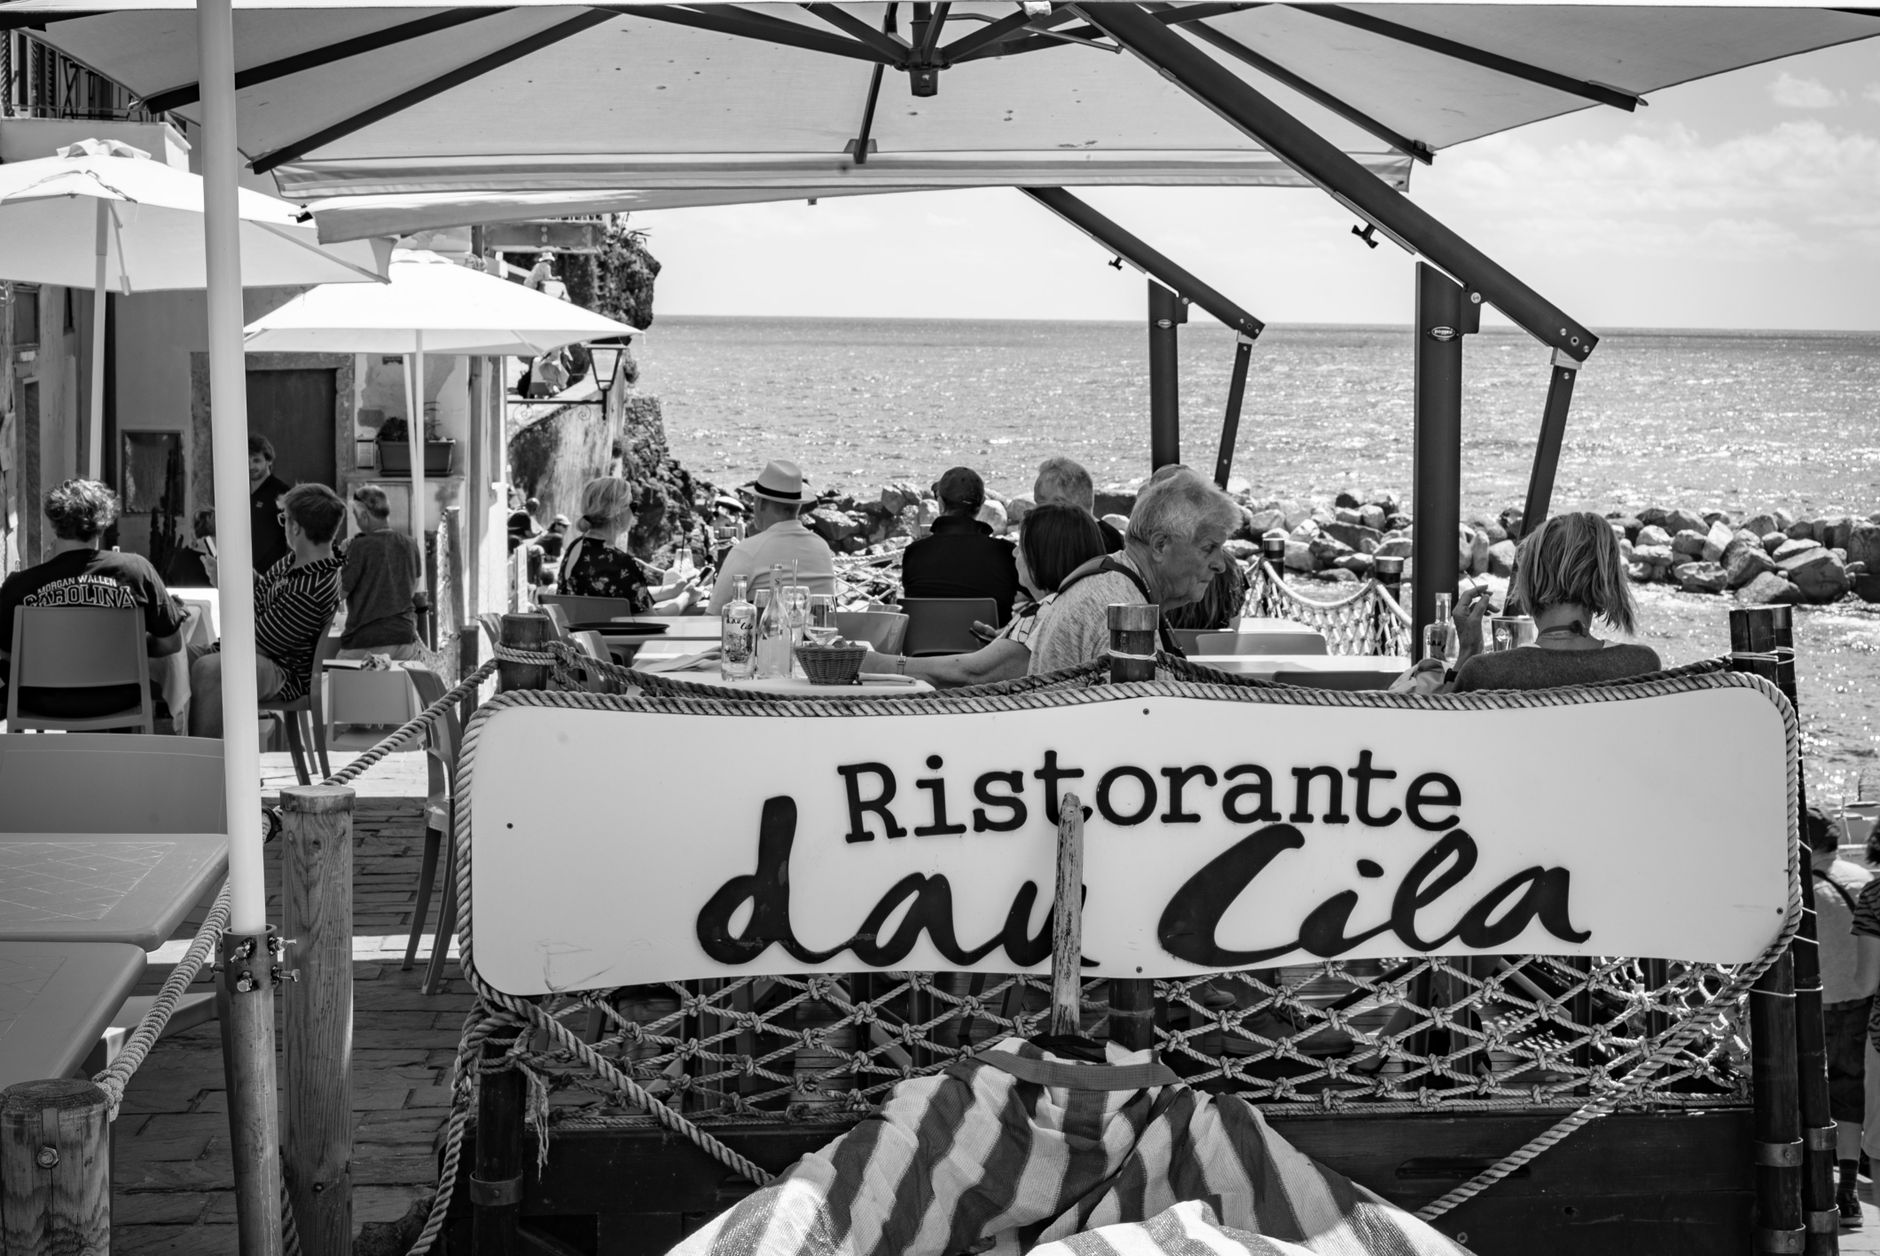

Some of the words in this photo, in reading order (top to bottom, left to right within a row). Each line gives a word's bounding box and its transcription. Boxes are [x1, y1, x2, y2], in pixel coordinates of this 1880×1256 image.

[23, 584, 138, 608] CAROLINA
[38, 577, 75, 594] MORGAN
[78, 574, 118, 587] WALLEN
[837, 749, 1462, 843] Ristorante
[1158, 823, 1591, 967] Cila
